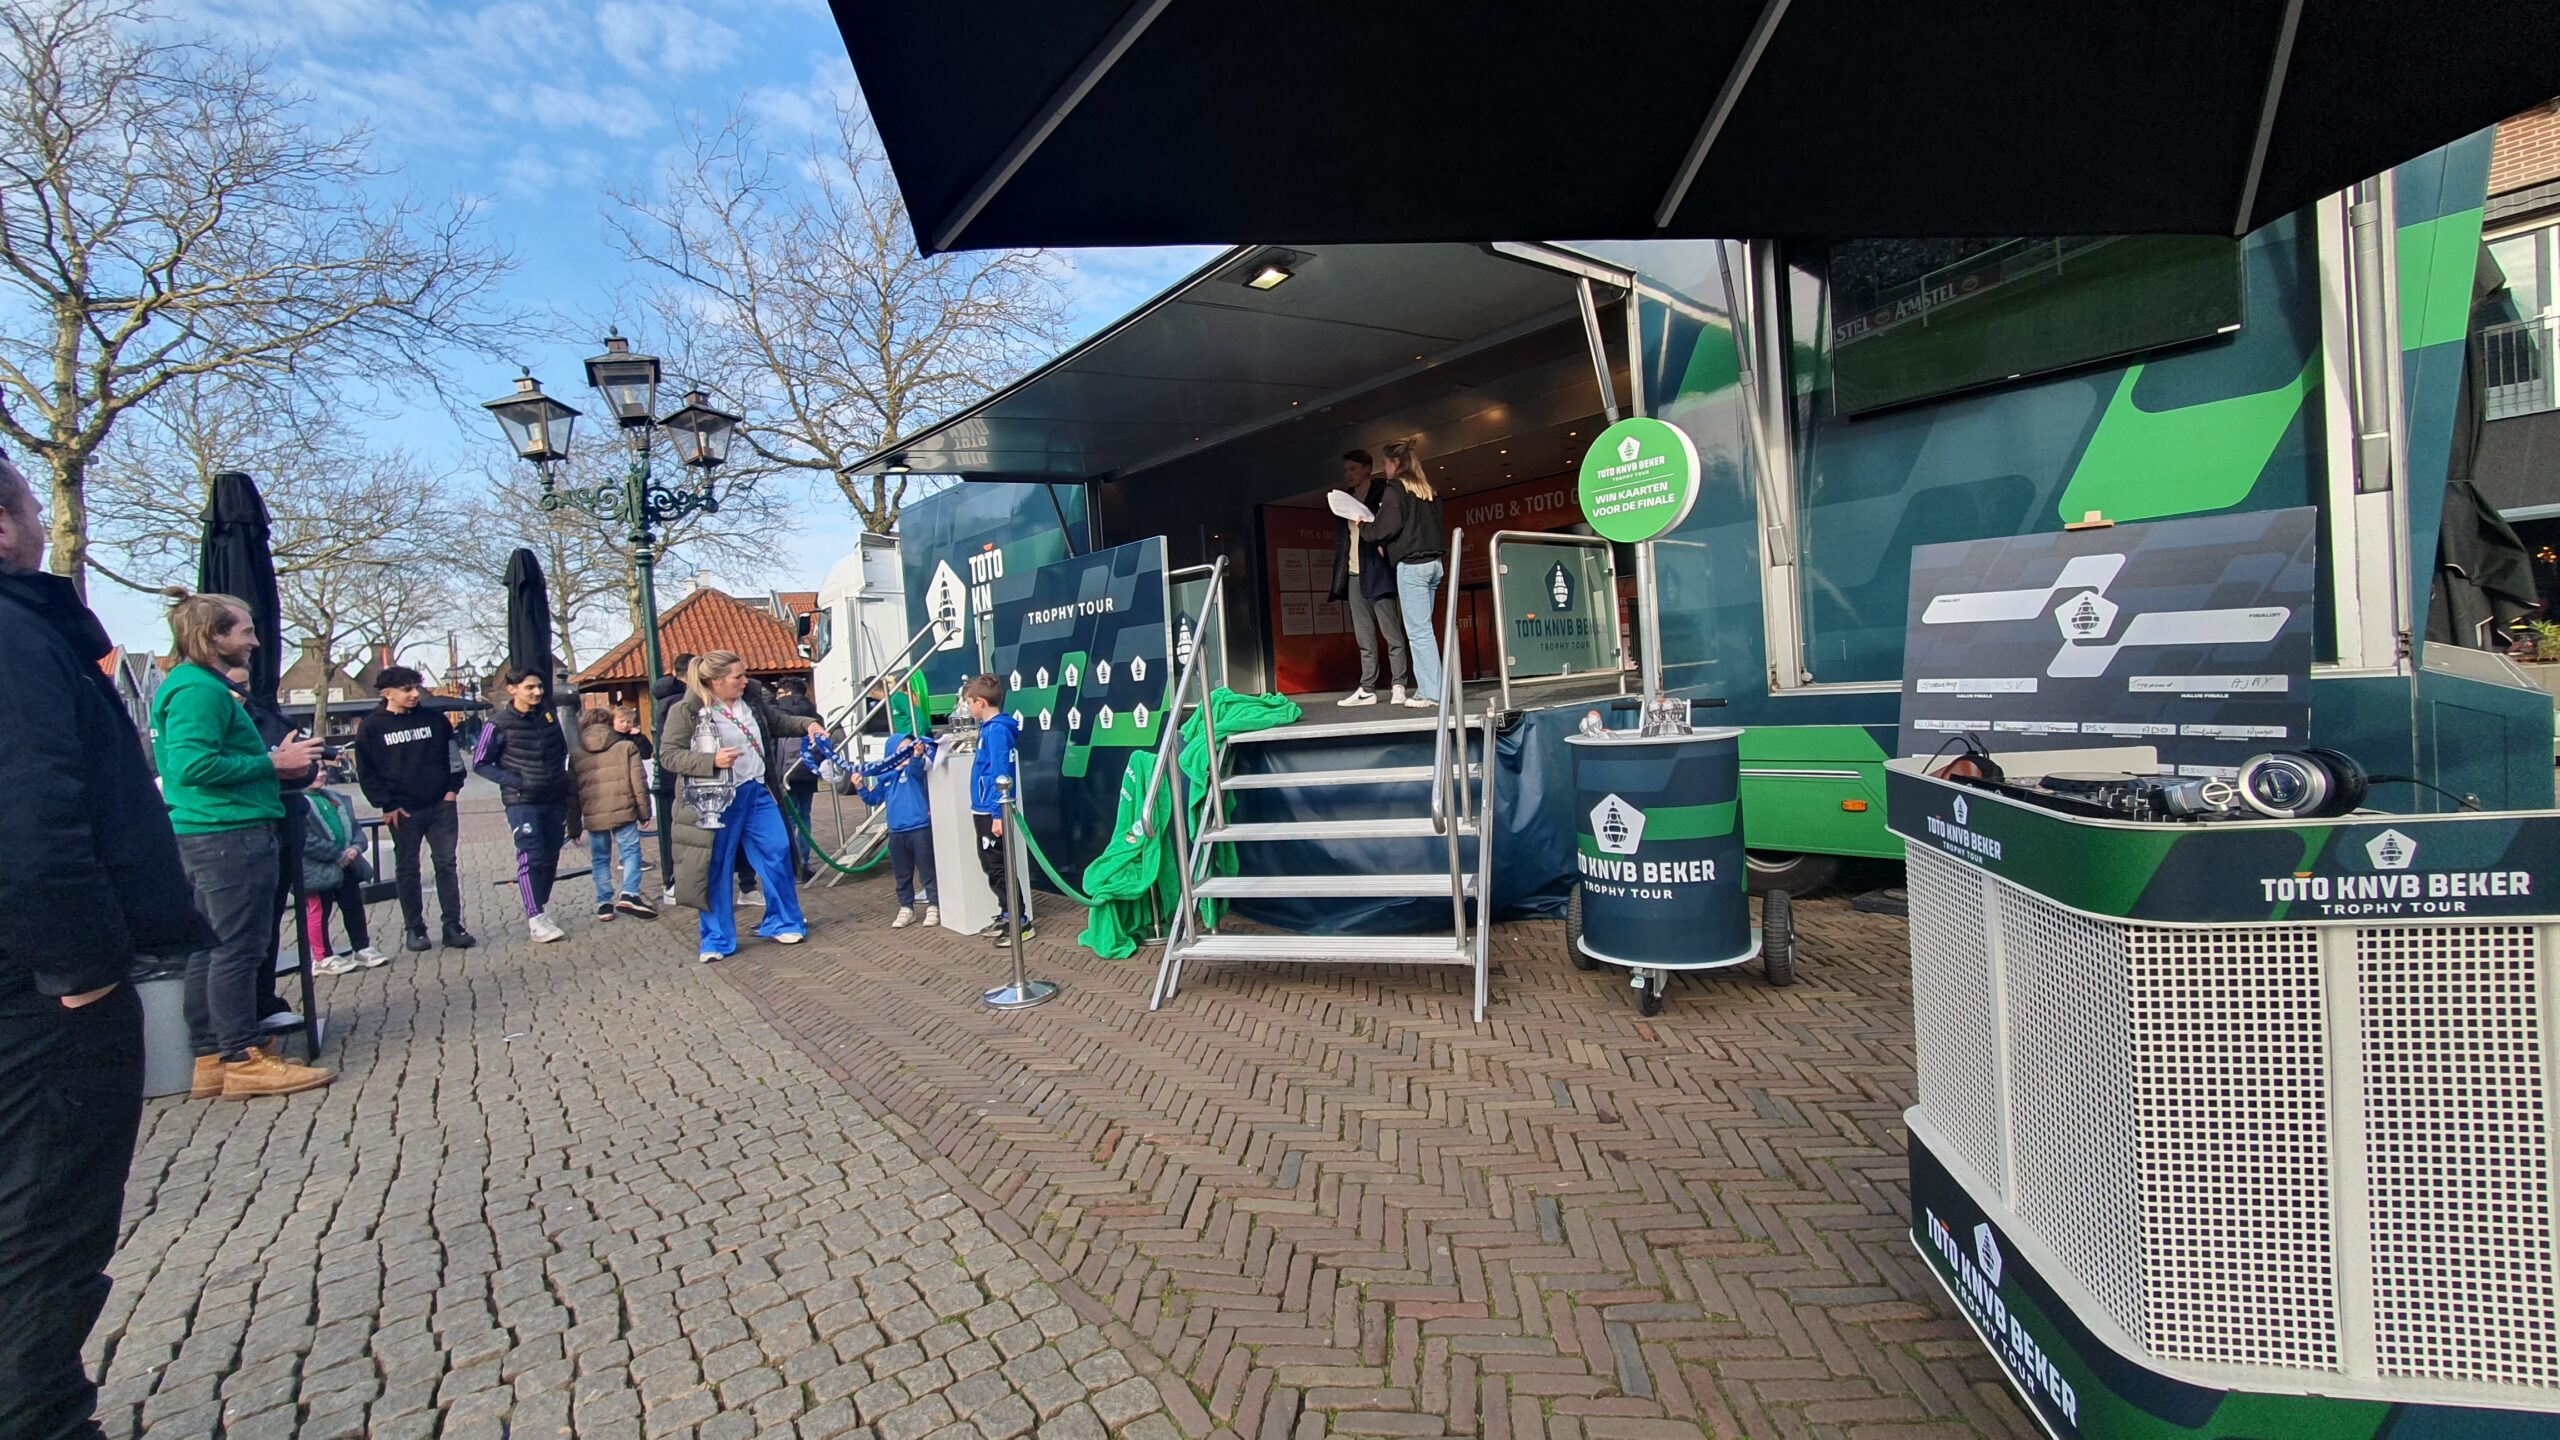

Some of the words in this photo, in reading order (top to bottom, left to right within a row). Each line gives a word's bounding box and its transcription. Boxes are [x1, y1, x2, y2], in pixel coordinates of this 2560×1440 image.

[1834, 316, 1871, 344] STEL
[1597, 468, 1615, 479] TOTO
[1616, 461, 1637, 474] KNVB
[1639, 456, 1665, 469] BEKER
[1592, 505, 1620, 517] VOOR
[1622, 503, 1636, 512] DE
[1638, 493, 1675, 508] FINALE
[1595, 492, 1616, 504] WIN
[1618, 482, 1668, 498] KAARTEN
[1466, 503, 1504, 526] KNVB
[1509, 500, 1520, 517] &
[1524, 490, 1564, 514] TOTO
[969, 547, 1003, 585] TOTO
[971, 583, 992, 615] KN
[1028, 604, 1074, 625] TROPHY
[1078, 597, 1114, 616] TOUR
[1515, 617, 1542, 638] TOTO
[1544, 617, 1574, 637] KNVB
[1540, 643, 1569, 652] TROPHY
[1571, 641, 1590, 650] TOUR
[1927, 815, 1945, 838] TOTO
[1946, 823, 1970, 847] KNVB
[1971, 832, 2001, 860] BEKER
[1943, 841, 1965, 856] TROPHY
[1966, 851, 1984, 864] TOUR
[1588, 857, 1637, 882] KNVB
[1643, 859, 1716, 883] BEKER
[1584, 881, 1625, 897] TROPHY
[1631, 889, 1673, 899] TOUR
[2261, 877, 2329, 902] TOTO
[2338, 874, 2421, 900] KNVB
[2428, 871, 2530, 898] BEKER
[2321, 903, 2402, 915] TROPHY
[2411, 901, 2467, 912] TOUR
[1925, 1207, 1959, 1271] TOTO
[1961, 1252, 2007, 1334] KNVB
[2010, 1314, 2077, 1427] BEKER
[1954, 1276, 1997, 1340] TROPHY
[2002, 1341, 2035, 1394] TOUR
